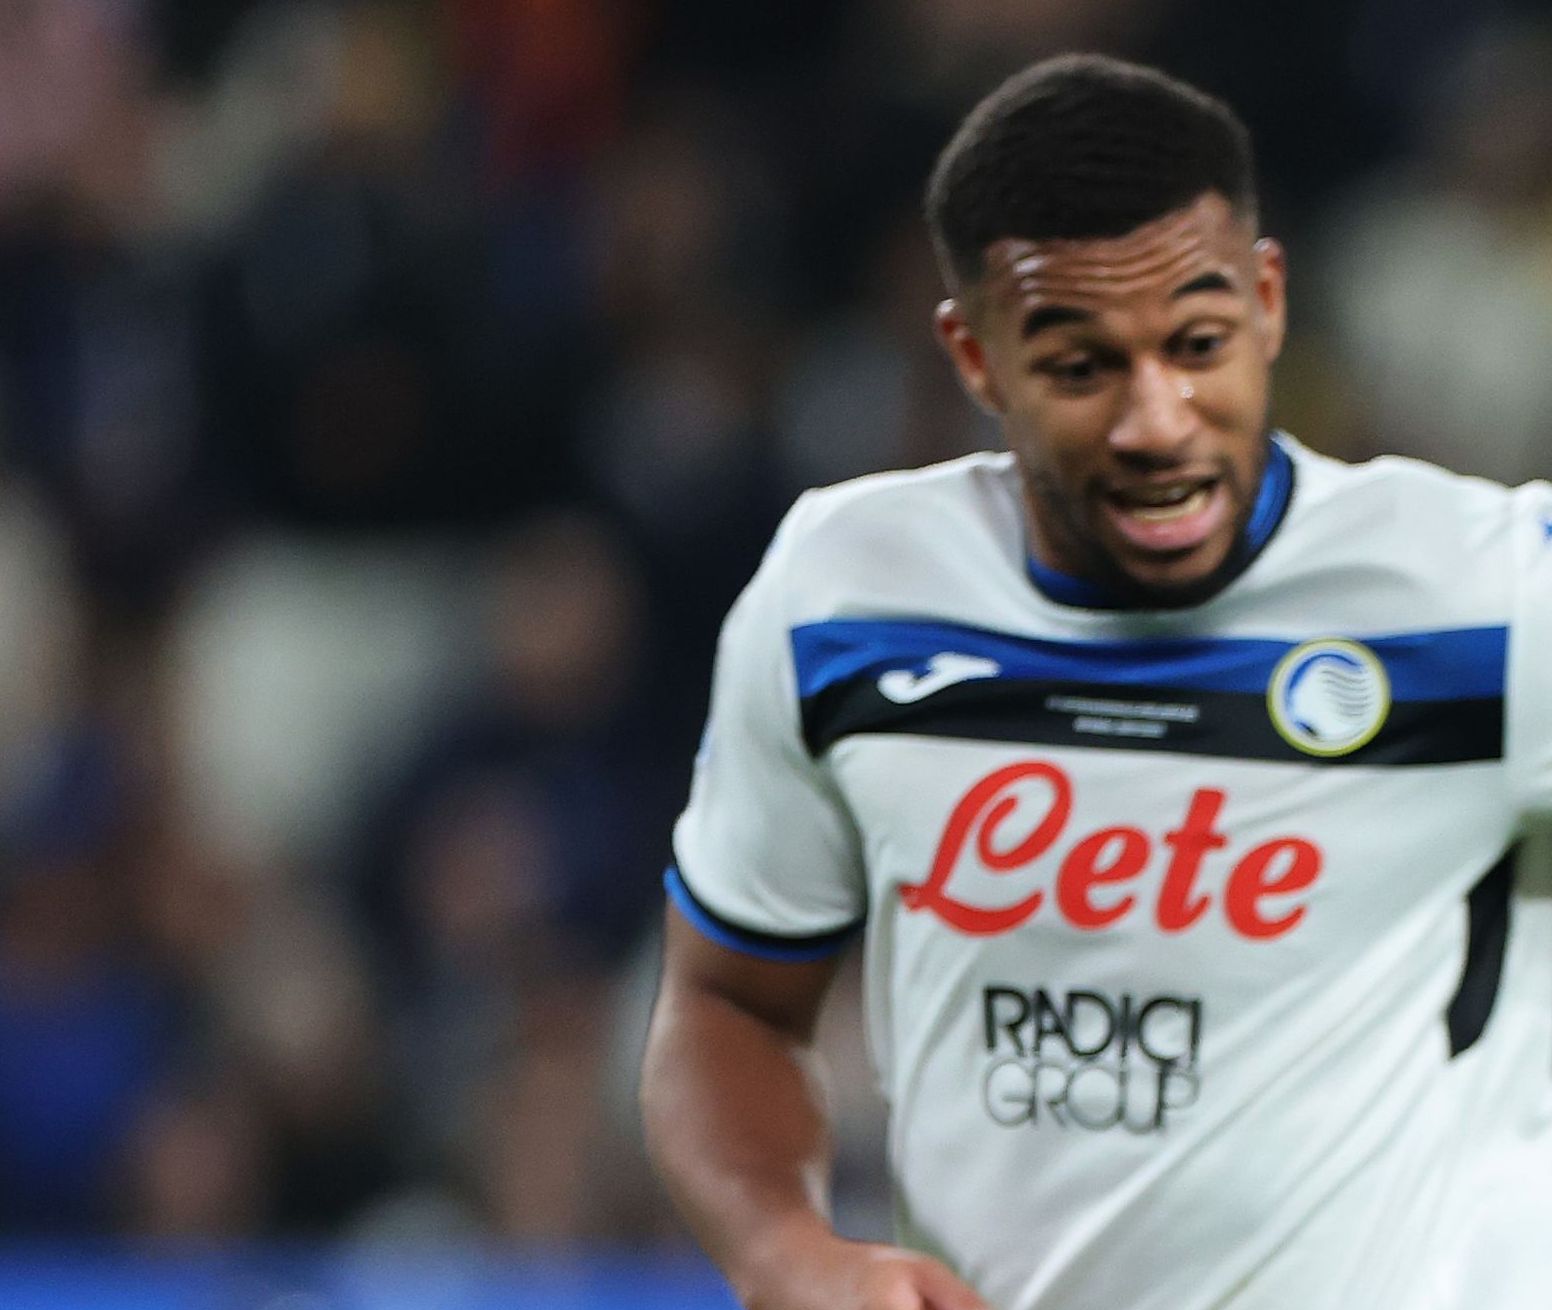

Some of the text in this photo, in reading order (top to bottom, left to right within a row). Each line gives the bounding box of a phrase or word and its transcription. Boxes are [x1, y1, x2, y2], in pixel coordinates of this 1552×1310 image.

[897, 761, 1323, 942] Lete
[983, 986, 1202, 1061] RADICI
[983, 1057, 1201, 1135] GROUP
